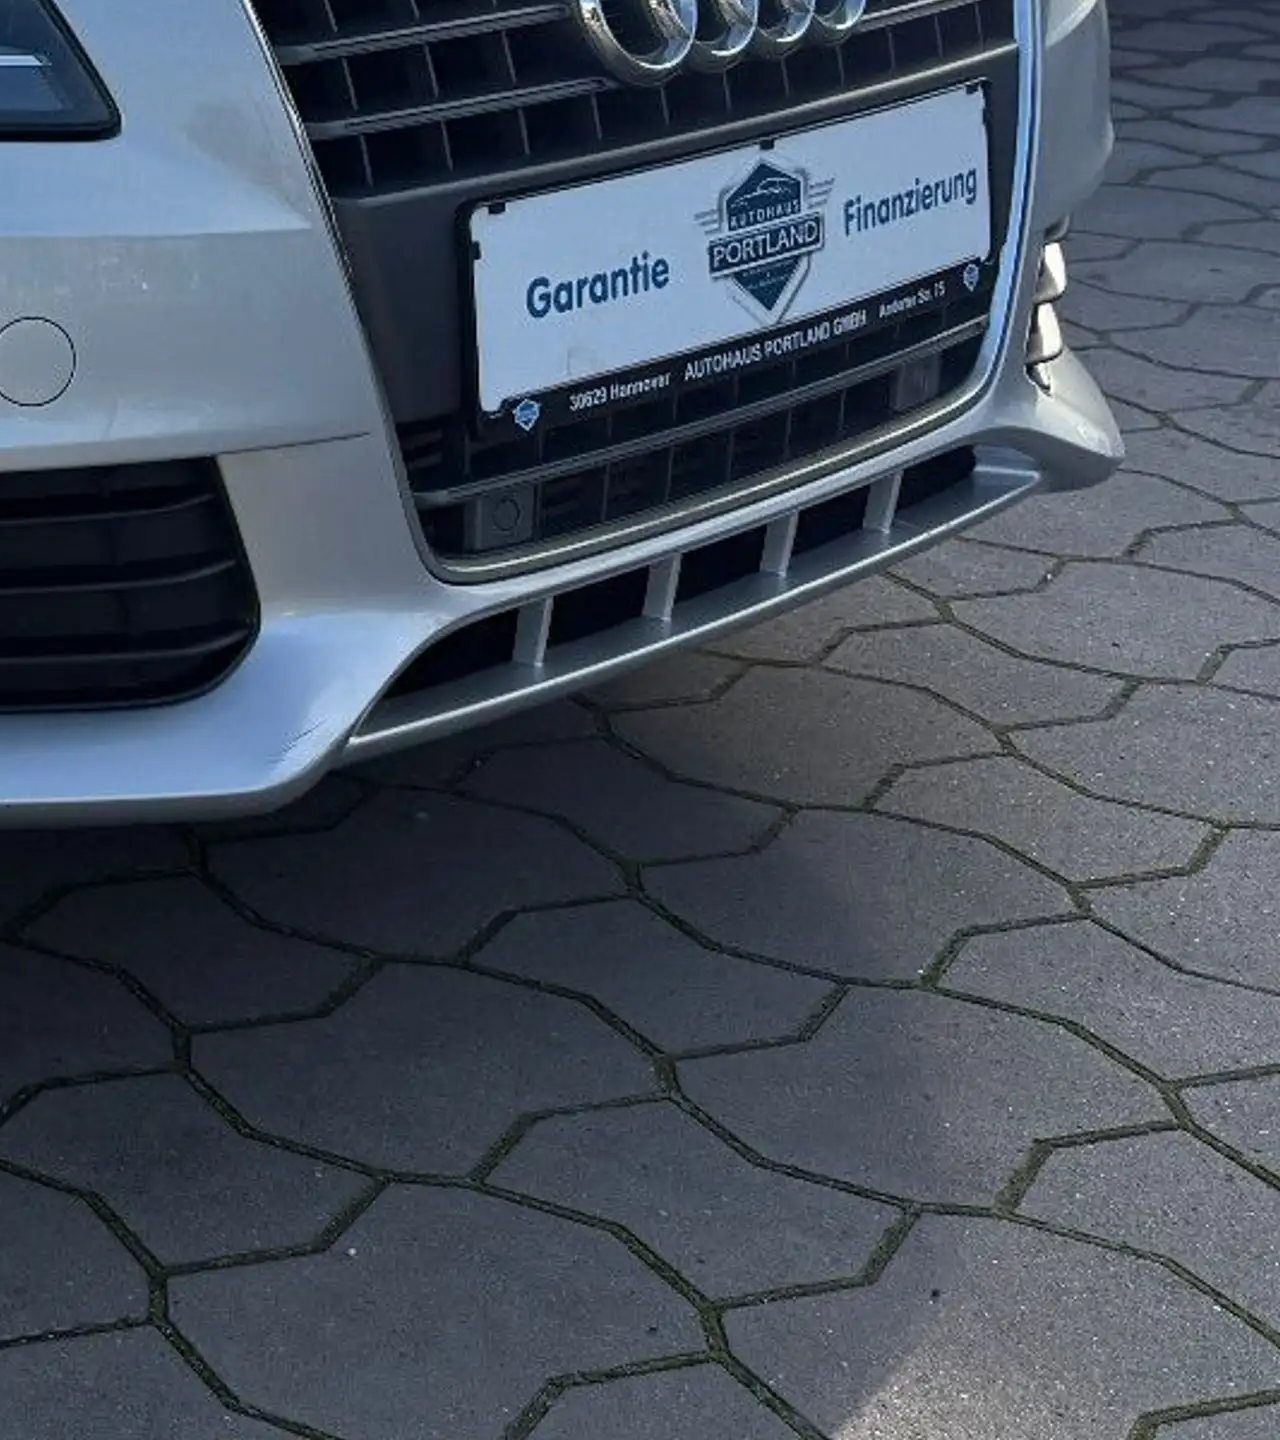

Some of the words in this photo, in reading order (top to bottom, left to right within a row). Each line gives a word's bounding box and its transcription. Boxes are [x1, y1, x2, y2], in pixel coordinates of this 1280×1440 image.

[526, 249, 670, 319] Garantie
[842, 167, 977, 238] Finanzierung
[712, 220, 818, 268] PORTLAND
[729, 198, 800, 230] AUTOHAUS
[568, 386, 608, 412] 30629
[610, 372, 671, 401] Hannover
[684, 342, 762, 381] AUTOHAUS
[764, 323, 830, 356] PORTLAND
